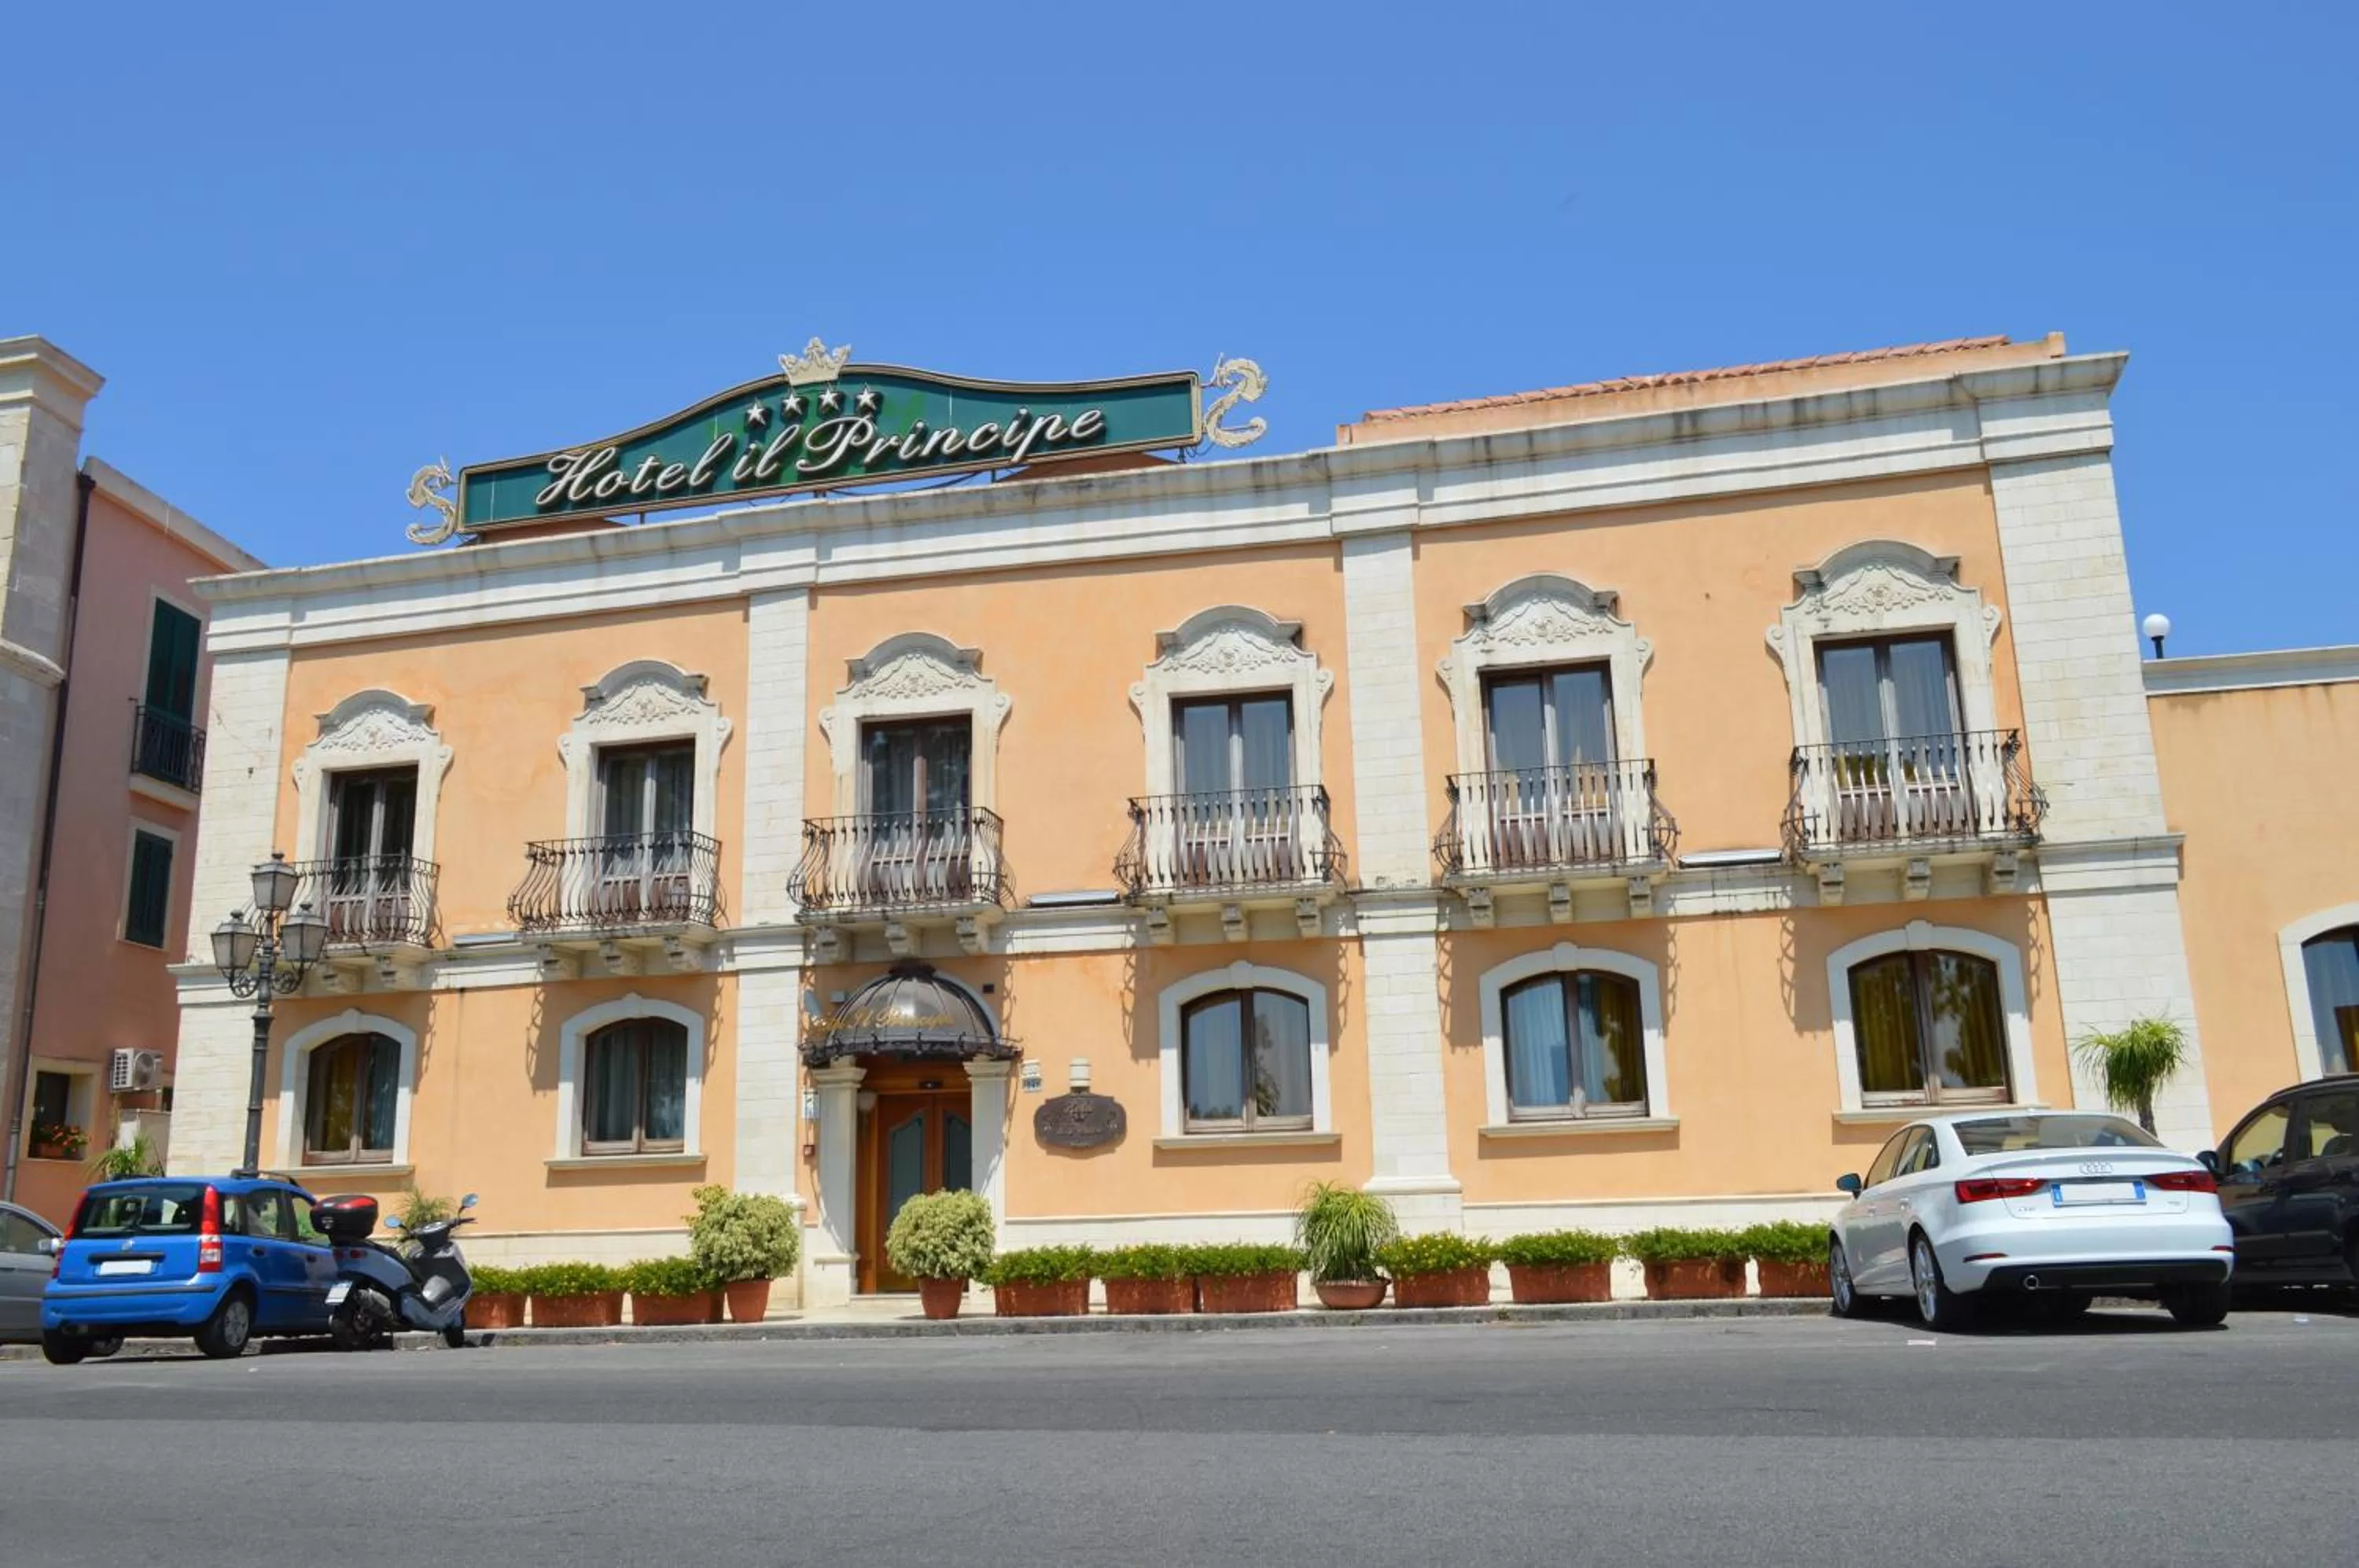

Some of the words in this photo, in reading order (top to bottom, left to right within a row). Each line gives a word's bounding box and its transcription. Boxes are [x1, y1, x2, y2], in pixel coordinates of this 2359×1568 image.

[535, 432, 734, 506] Hotel
[731, 424, 801, 481] il
[795, 407, 1104, 473] Principe
